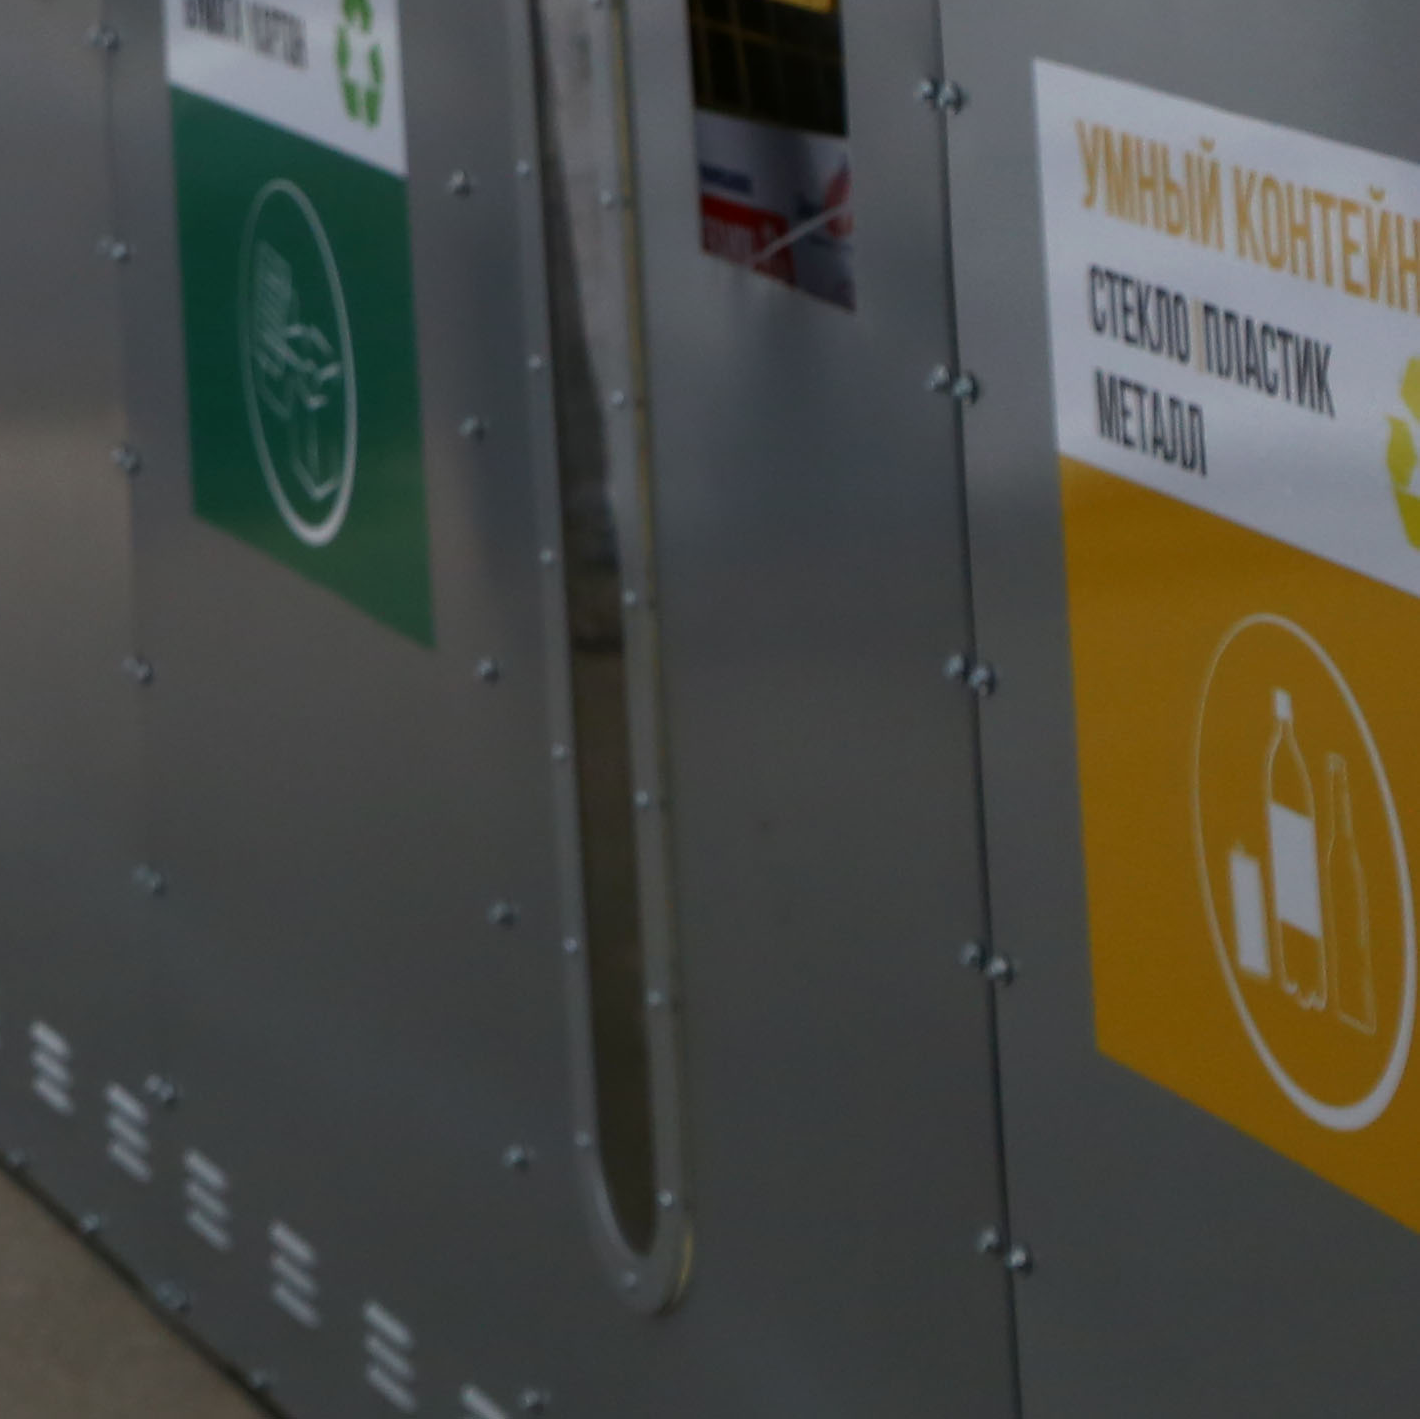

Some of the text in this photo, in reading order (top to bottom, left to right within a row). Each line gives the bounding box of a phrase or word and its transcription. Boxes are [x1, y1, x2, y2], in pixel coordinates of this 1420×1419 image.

[1075, 118, 1224, 253] УМНЫЙ
[1088, 263, 1337, 419] СТЕКЛО ПЛАСТИК
[1095, 367, 1208, 476] МЕТАЛЛ
